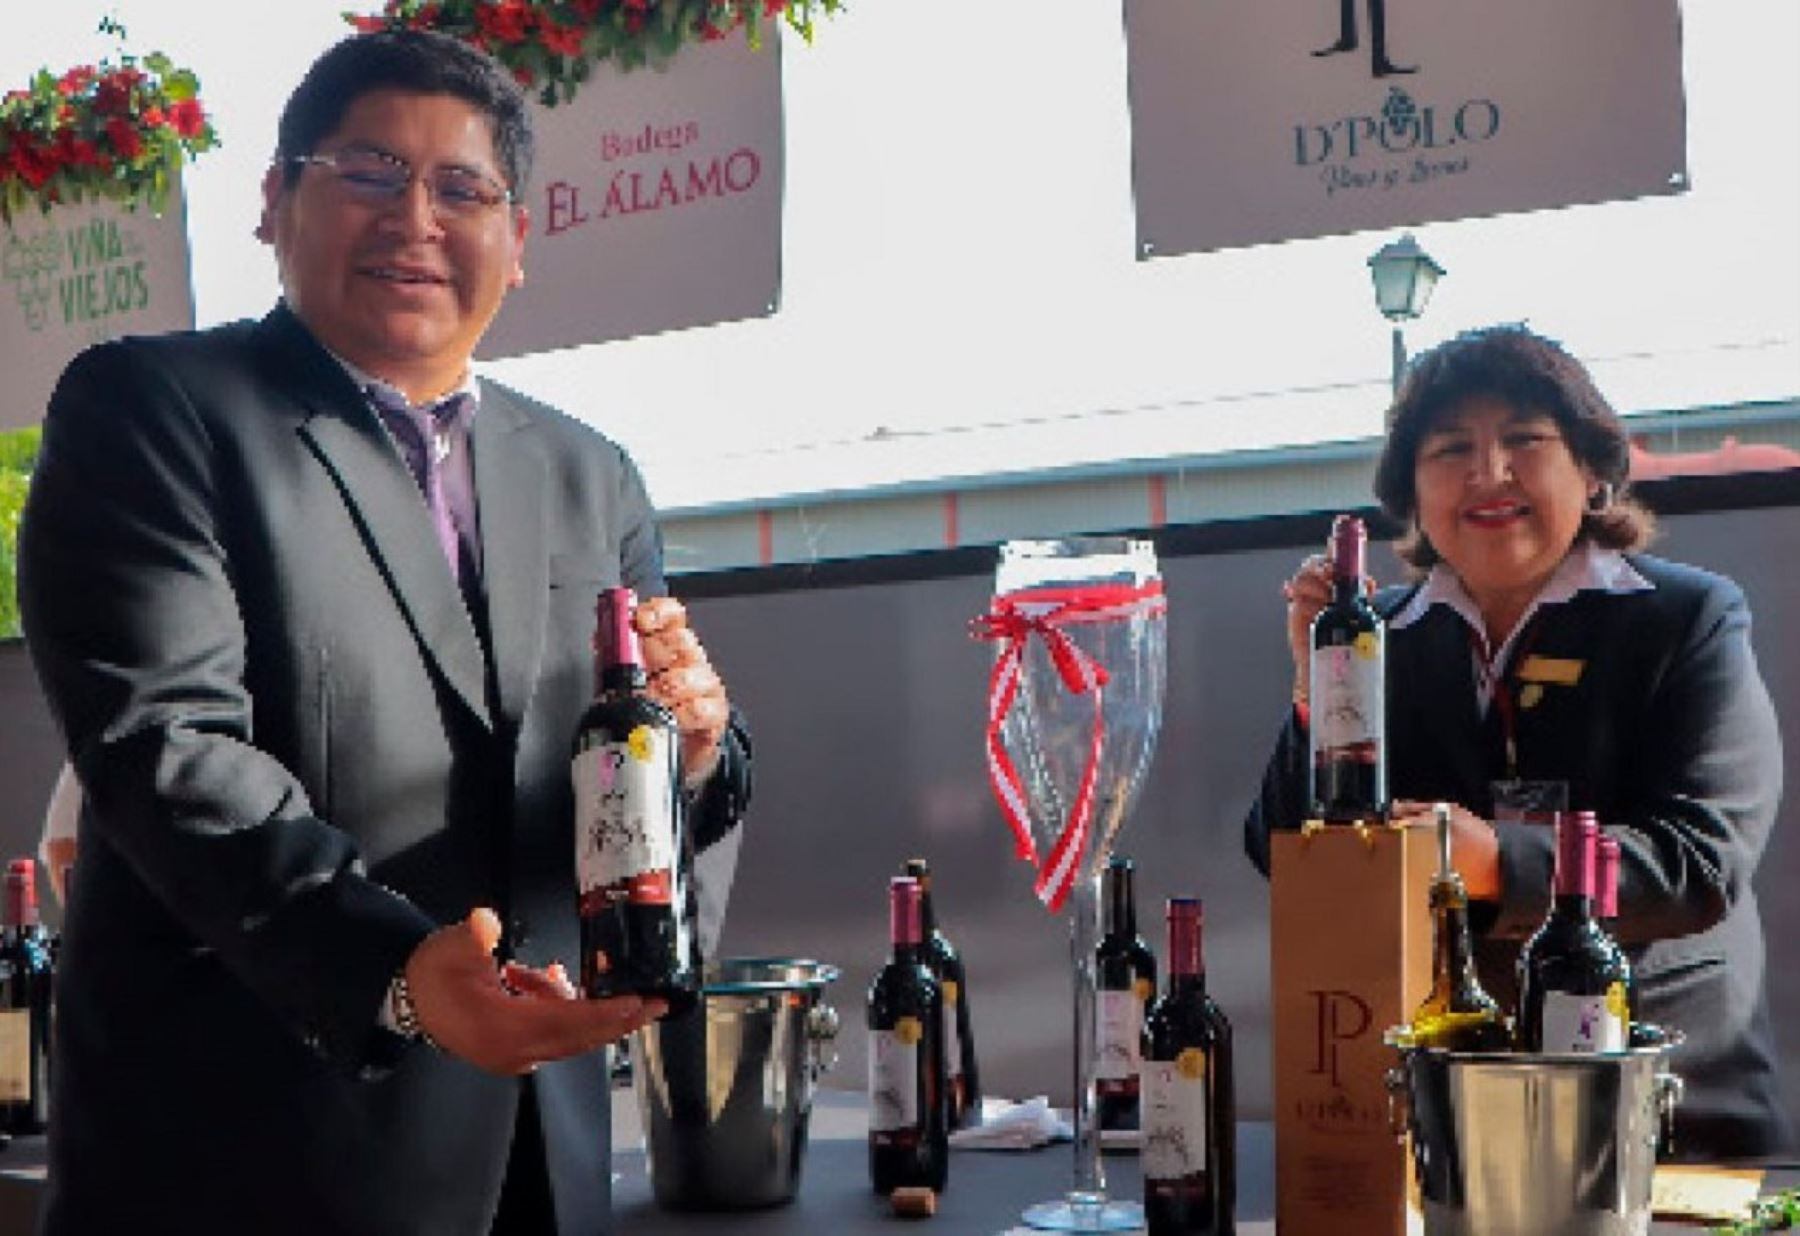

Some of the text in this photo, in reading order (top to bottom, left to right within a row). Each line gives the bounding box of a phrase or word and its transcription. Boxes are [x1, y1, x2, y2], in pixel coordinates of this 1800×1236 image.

[602, 121, 699, 162] Bodega
[545, 146, 761, 227] EL ÁLAMO
[59, 260, 148, 325] VIEJOS
